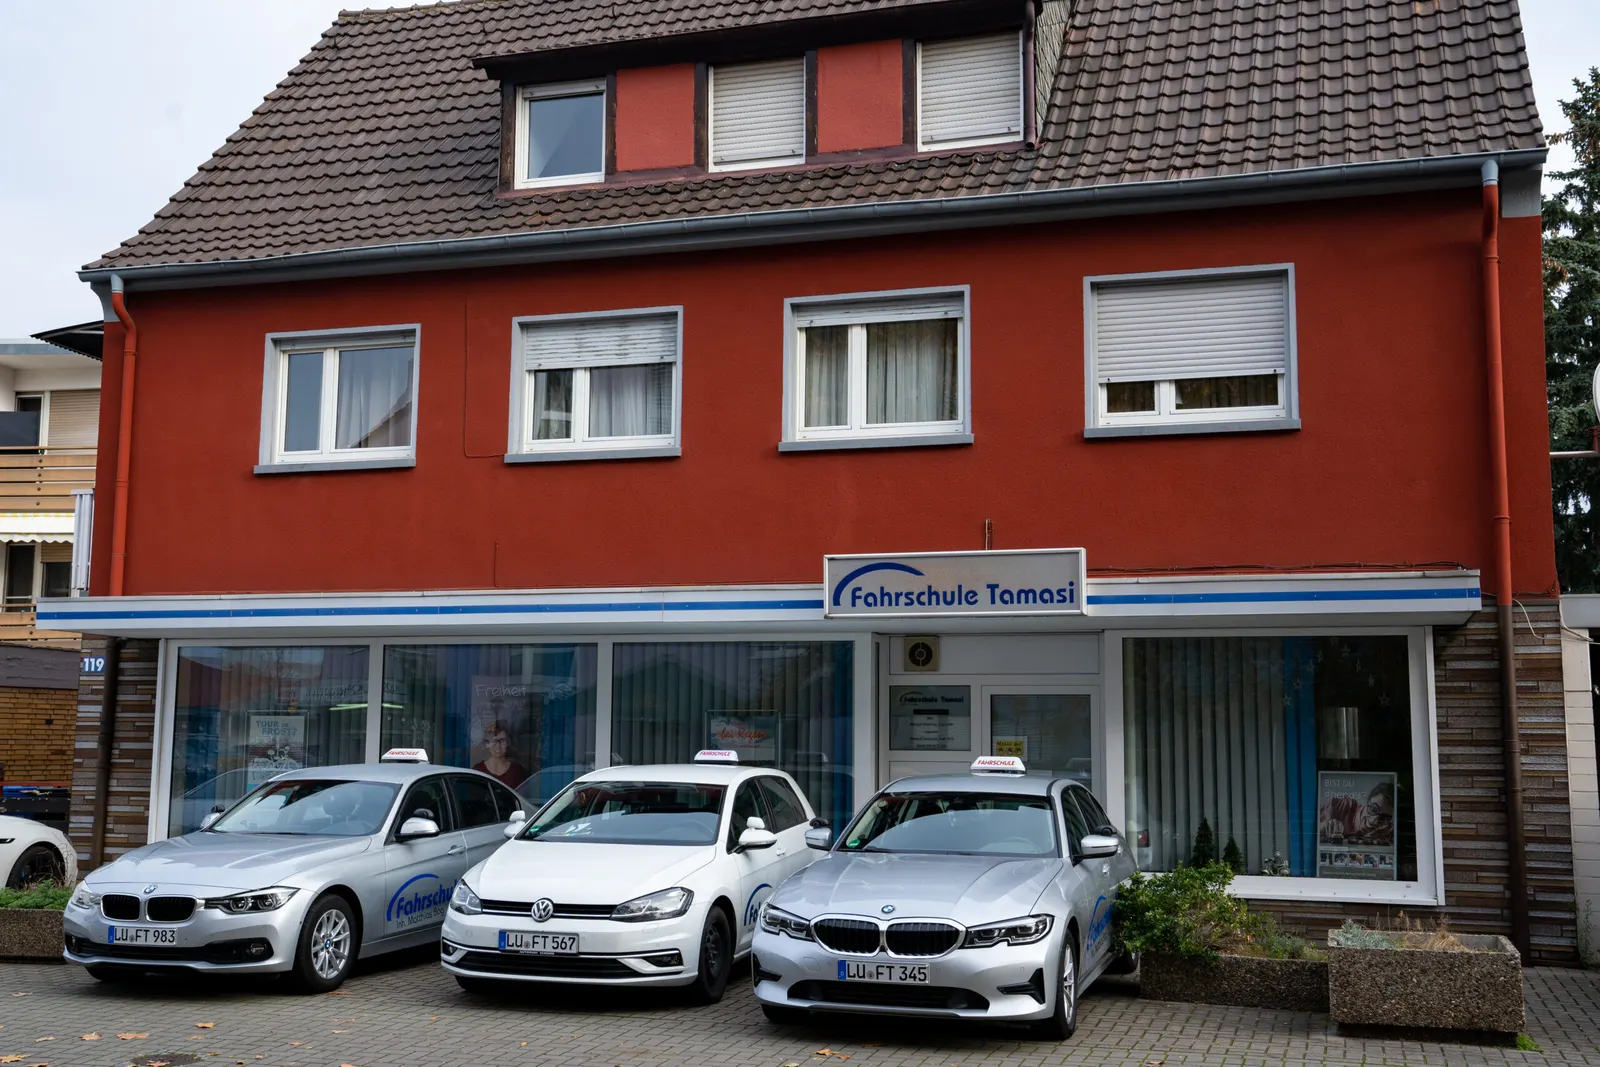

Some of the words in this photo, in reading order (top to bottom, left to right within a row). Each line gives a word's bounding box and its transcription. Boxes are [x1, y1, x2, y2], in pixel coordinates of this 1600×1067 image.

[851, 584, 979, 608] Fahrschule
[986, 581, 1075, 605] Tamasi
[83, 657, 105, 672] 119
[476, 684, 527, 697] Freiheit
[255, 720, 279, 728] TOUR
[261, 727, 298, 737] FROST?
[114, 927, 129, 941] LU
[135, 929, 150, 942] FT
[153, 929, 176, 943] 983
[506, 933, 523, 948] LU
[532, 935, 549, 949] FT
[551, 936, 576, 950] 567
[847, 963, 866, 979] LU
[876, 965, 895, 980] FT
[899, 966, 927, 981] 345
